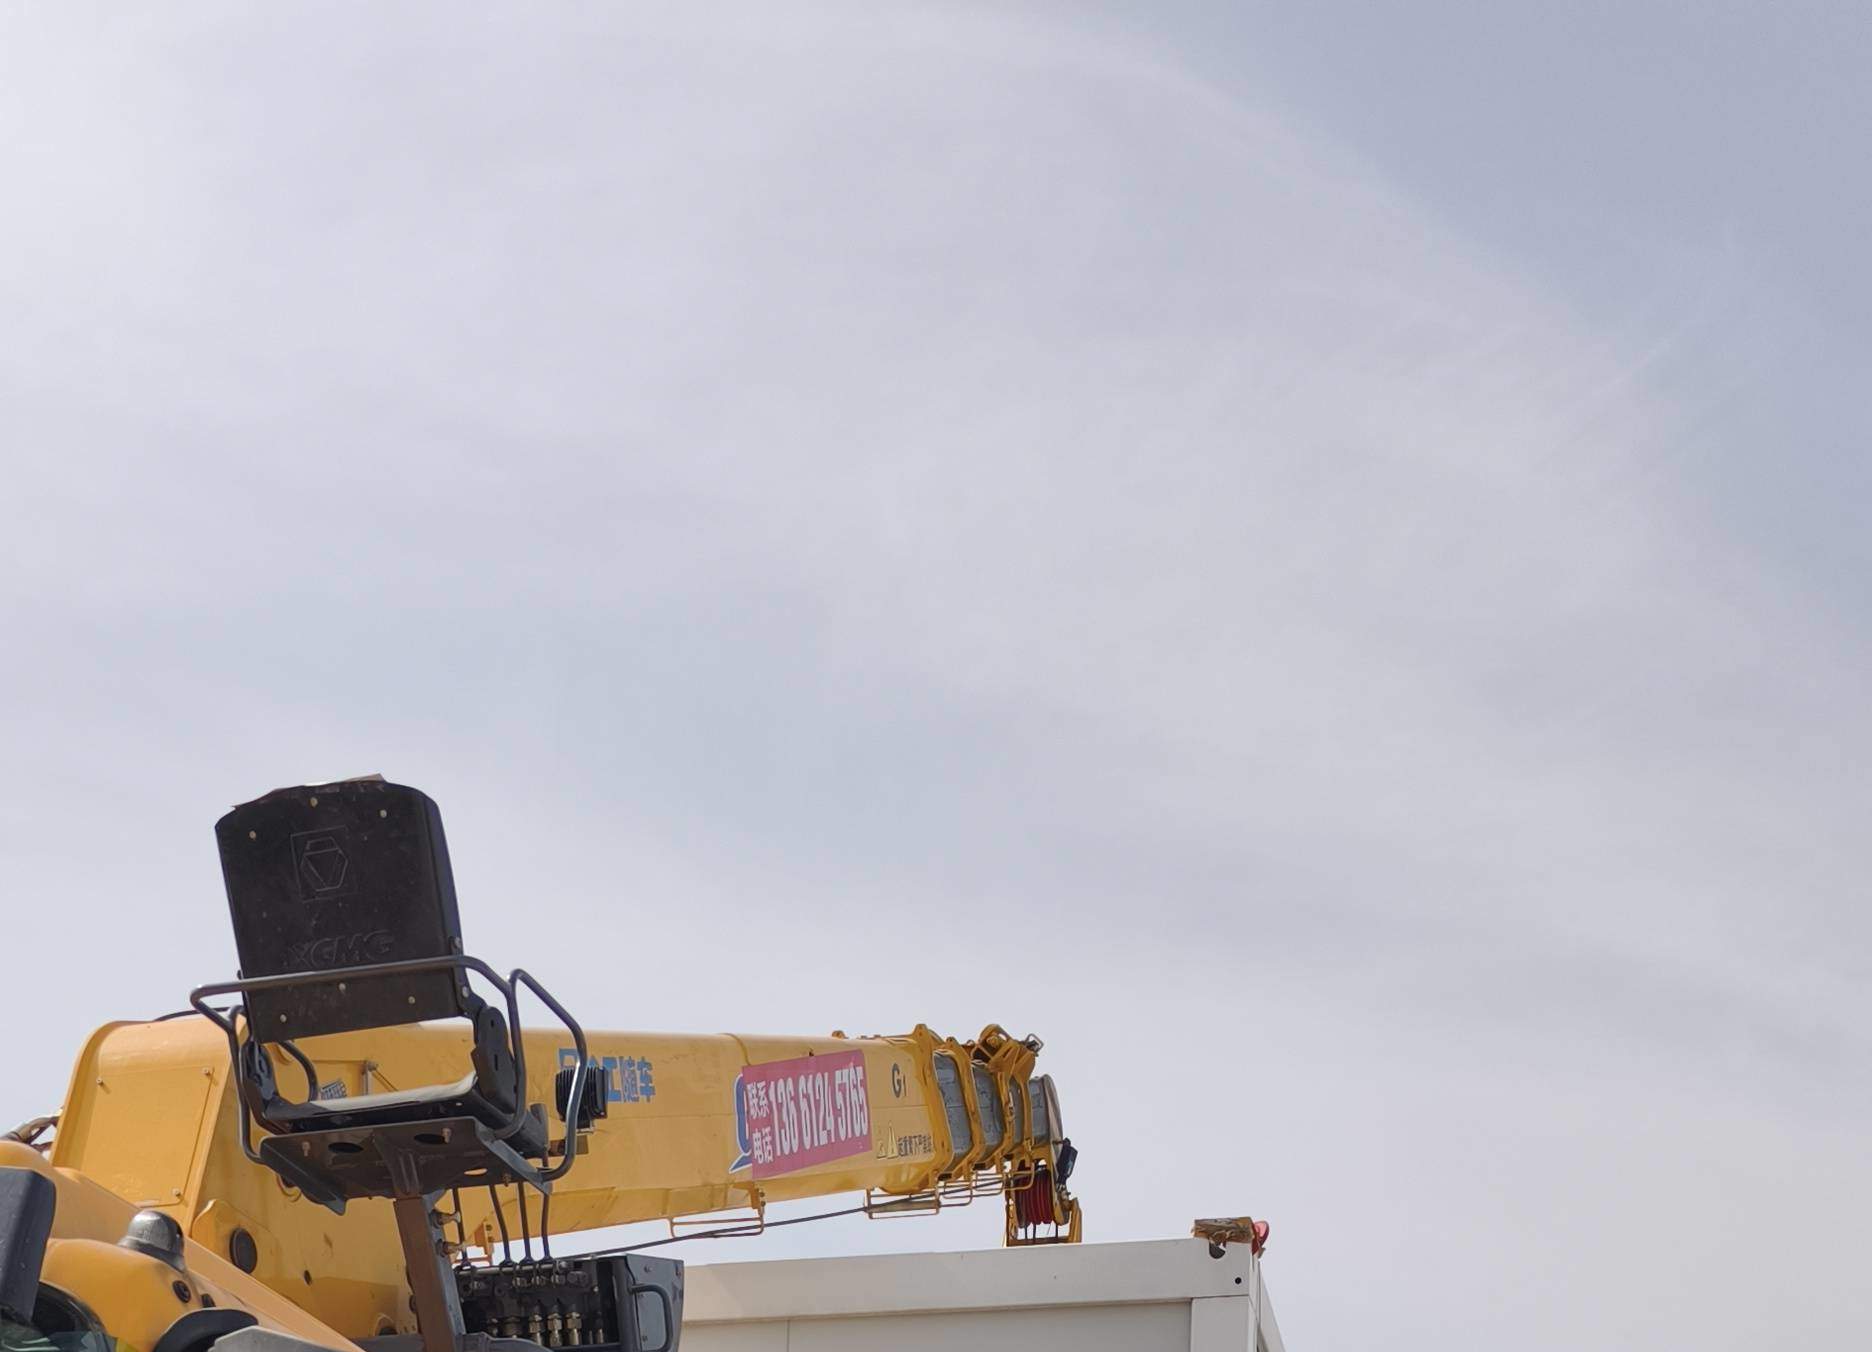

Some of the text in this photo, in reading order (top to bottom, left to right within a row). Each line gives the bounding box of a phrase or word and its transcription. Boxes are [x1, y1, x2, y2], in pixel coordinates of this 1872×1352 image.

[287, 929, 395, 970] XCMG
[747, 1080, 770, 1120] 联系
[768, 1065, 868, 1156] 136 6124 5765
[752, 1125, 775, 1165] 电话
